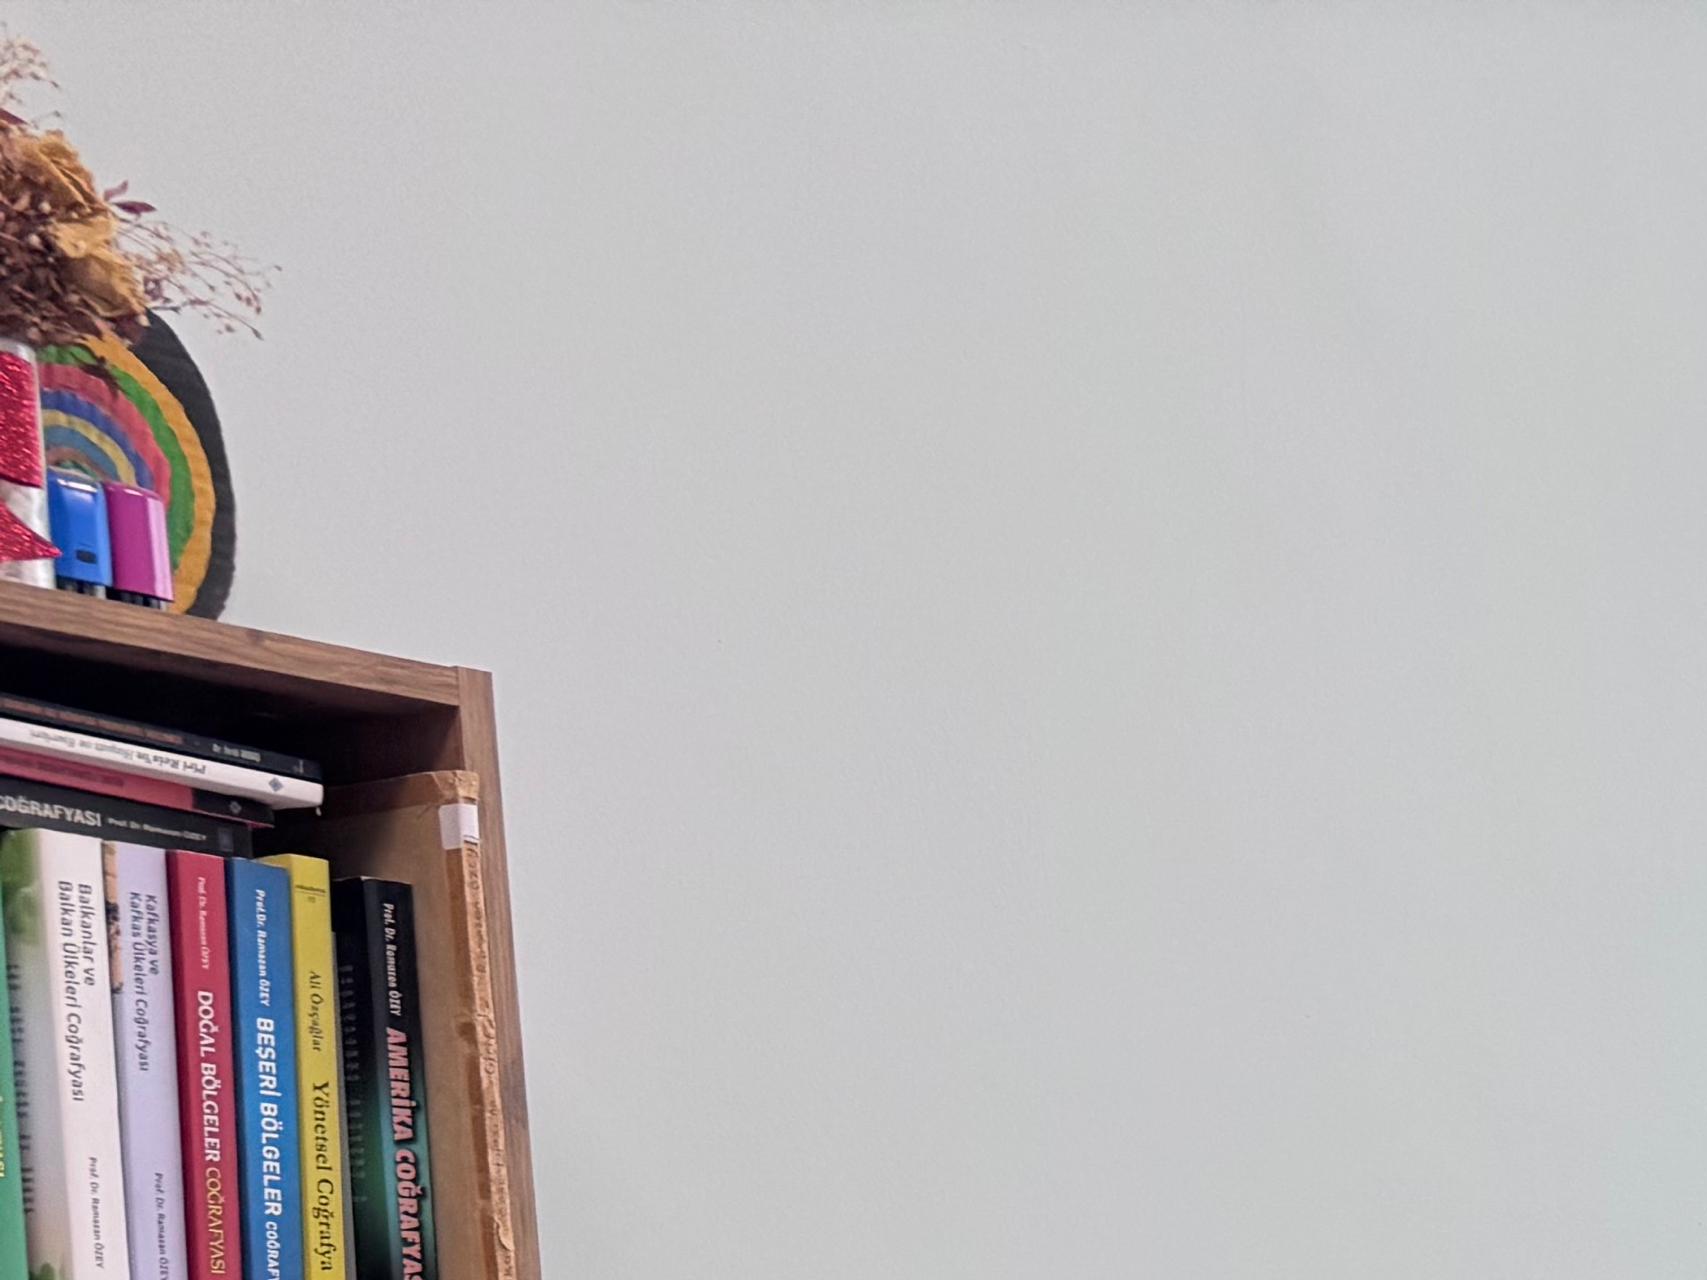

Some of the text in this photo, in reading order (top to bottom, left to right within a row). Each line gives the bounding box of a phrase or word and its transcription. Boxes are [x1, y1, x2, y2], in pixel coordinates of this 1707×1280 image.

[78, 884, 97, 986] Balkanlar ve
[143, 894, 161, 975] Kafkasya ve
[256, 930, 267, 976] Ramazan
[57, 880, 86, 1103] Balkan Ülkeleri Coğrafyası
[129, 892, 151, 1072] Kafkas Ülkeleri Coğrafyası
[259, 979, 271, 1006] ÖZEY
[308, 970, 321, 991] Ali
[388, 990, 401, 1016] ÖZEY
[255, 1016, 281, 1096] BEŞERİ
[386, 1027, 416, 1141] AMERİKA
[197, 991, 226, 1273] DOĞAL BÖLGELER COĞRAFYASI
[260, 1102, 284, 1215] BÖLGELER
[311, 1081, 333, 1171] Yönetsel
[312, 1178, 336, 1271] Coğrafya
